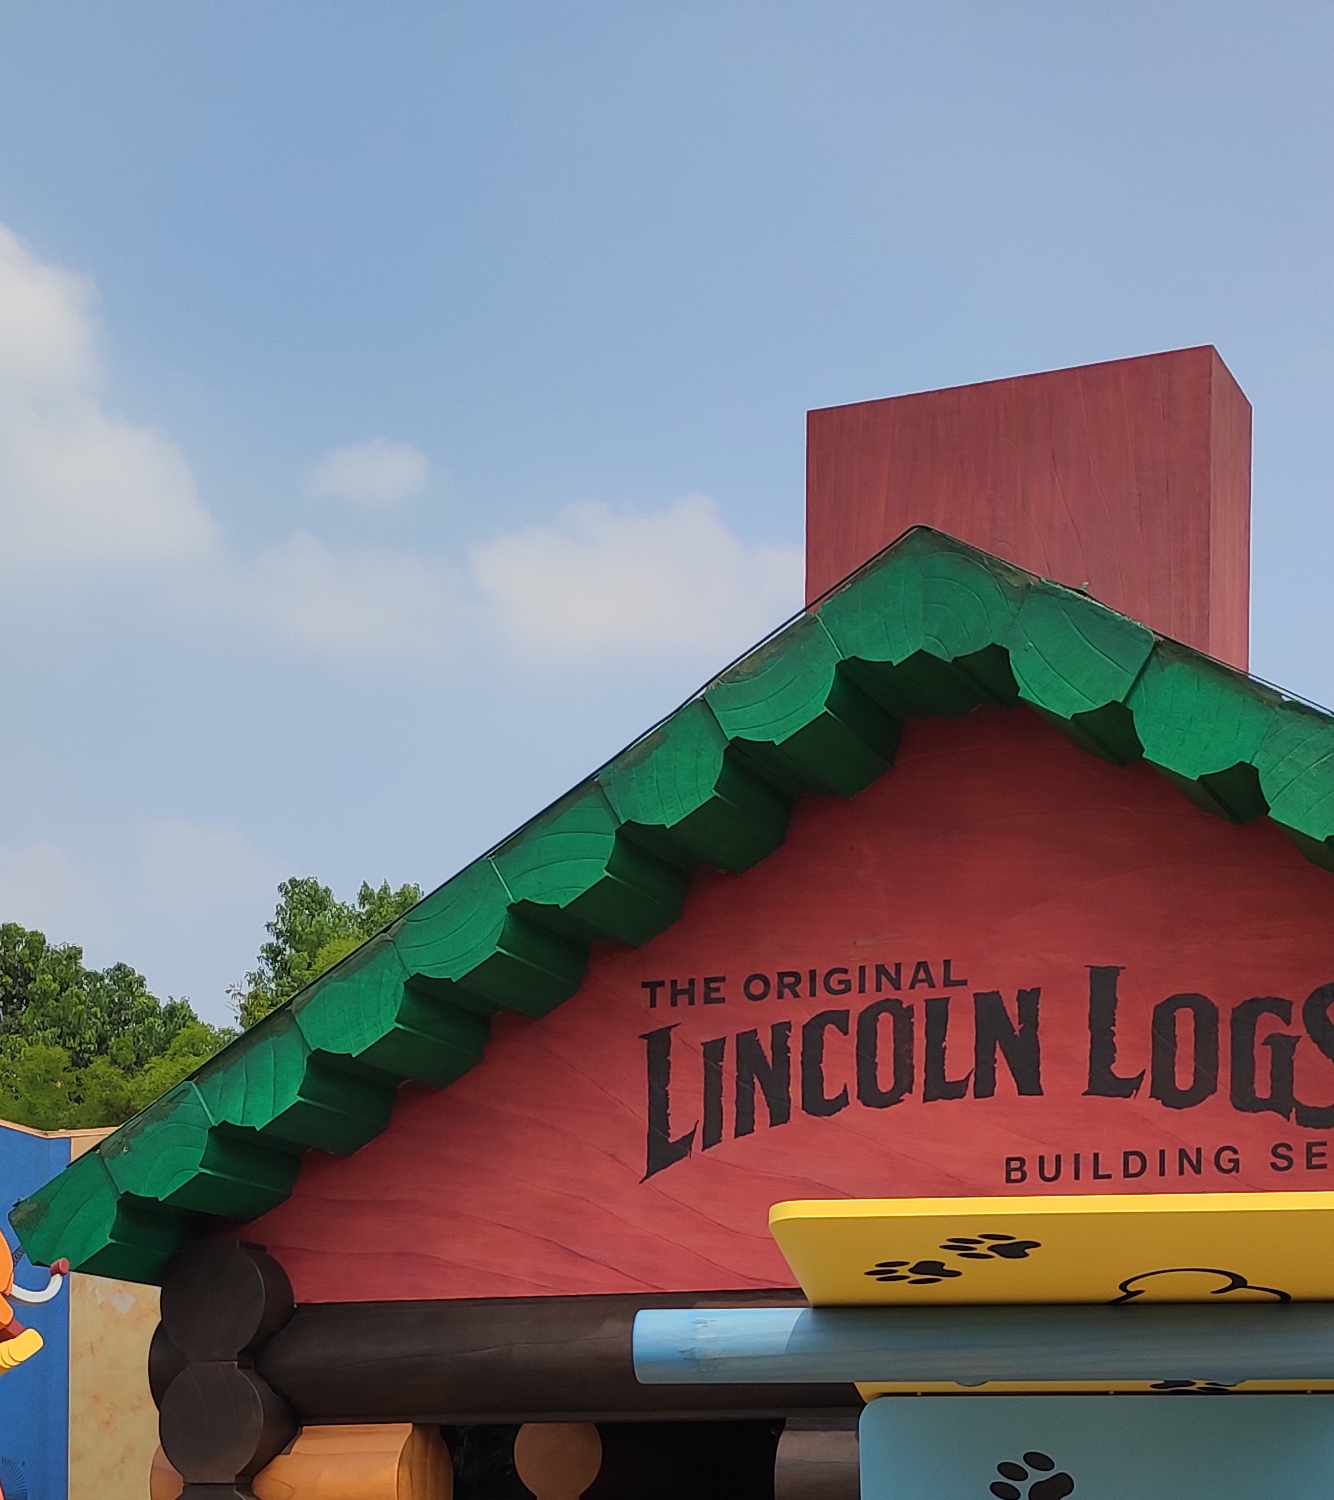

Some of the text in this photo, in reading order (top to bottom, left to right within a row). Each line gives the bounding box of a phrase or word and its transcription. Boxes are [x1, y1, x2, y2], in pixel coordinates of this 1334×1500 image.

[641, 958, 969, 1009] THE ORIGINAL
[639, 985, 1044, 1185] LINCOLN
[1004, 1144, 1242, 1185] BUILDING
